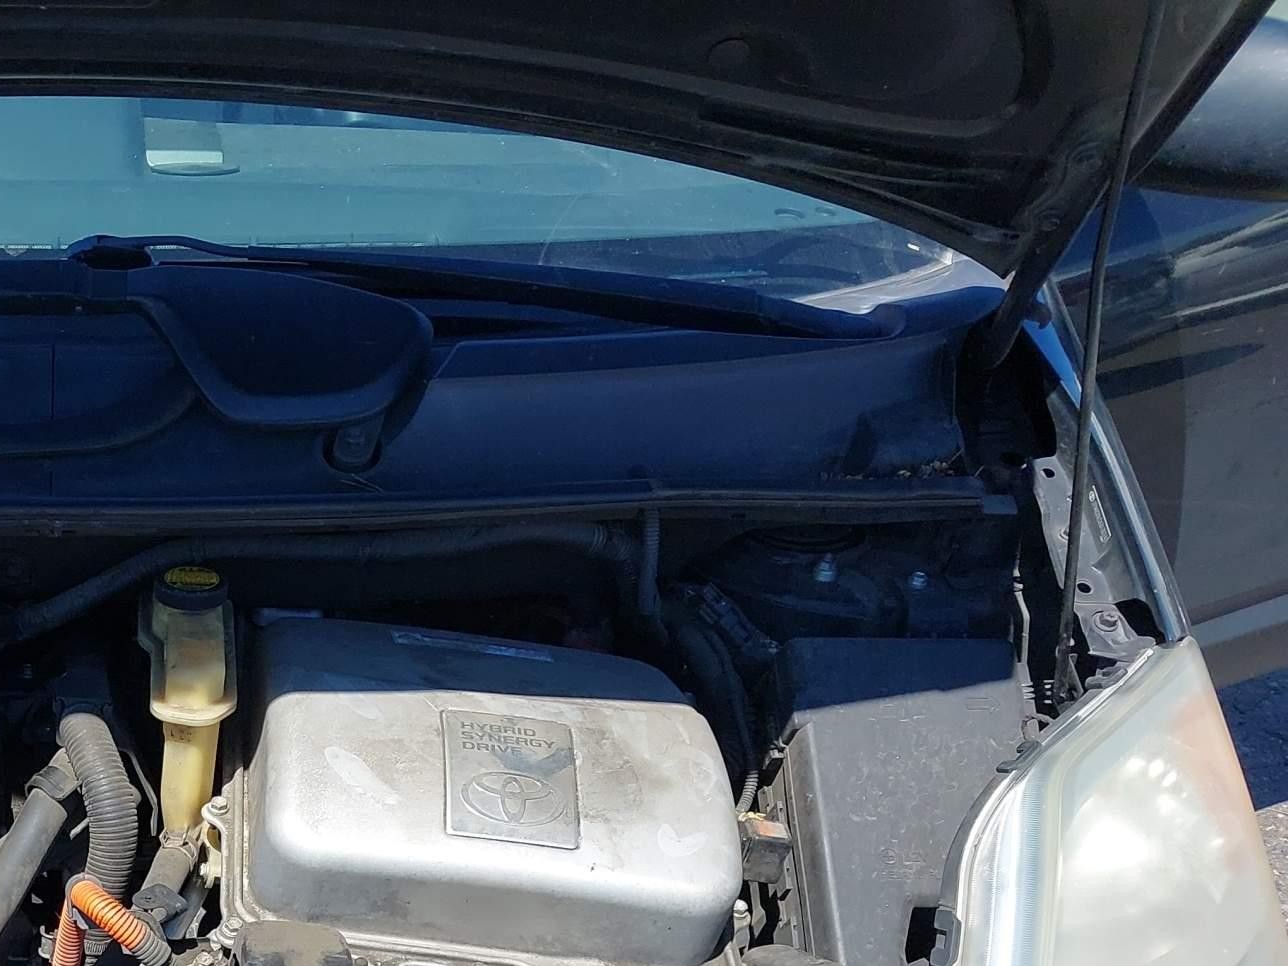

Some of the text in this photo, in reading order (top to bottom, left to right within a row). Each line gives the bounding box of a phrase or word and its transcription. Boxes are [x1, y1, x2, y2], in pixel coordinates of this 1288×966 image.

[461, 721, 537, 737] HYBRID
[460, 731, 556, 750] SYNERGY
[461, 741, 522, 754] DRIVE
